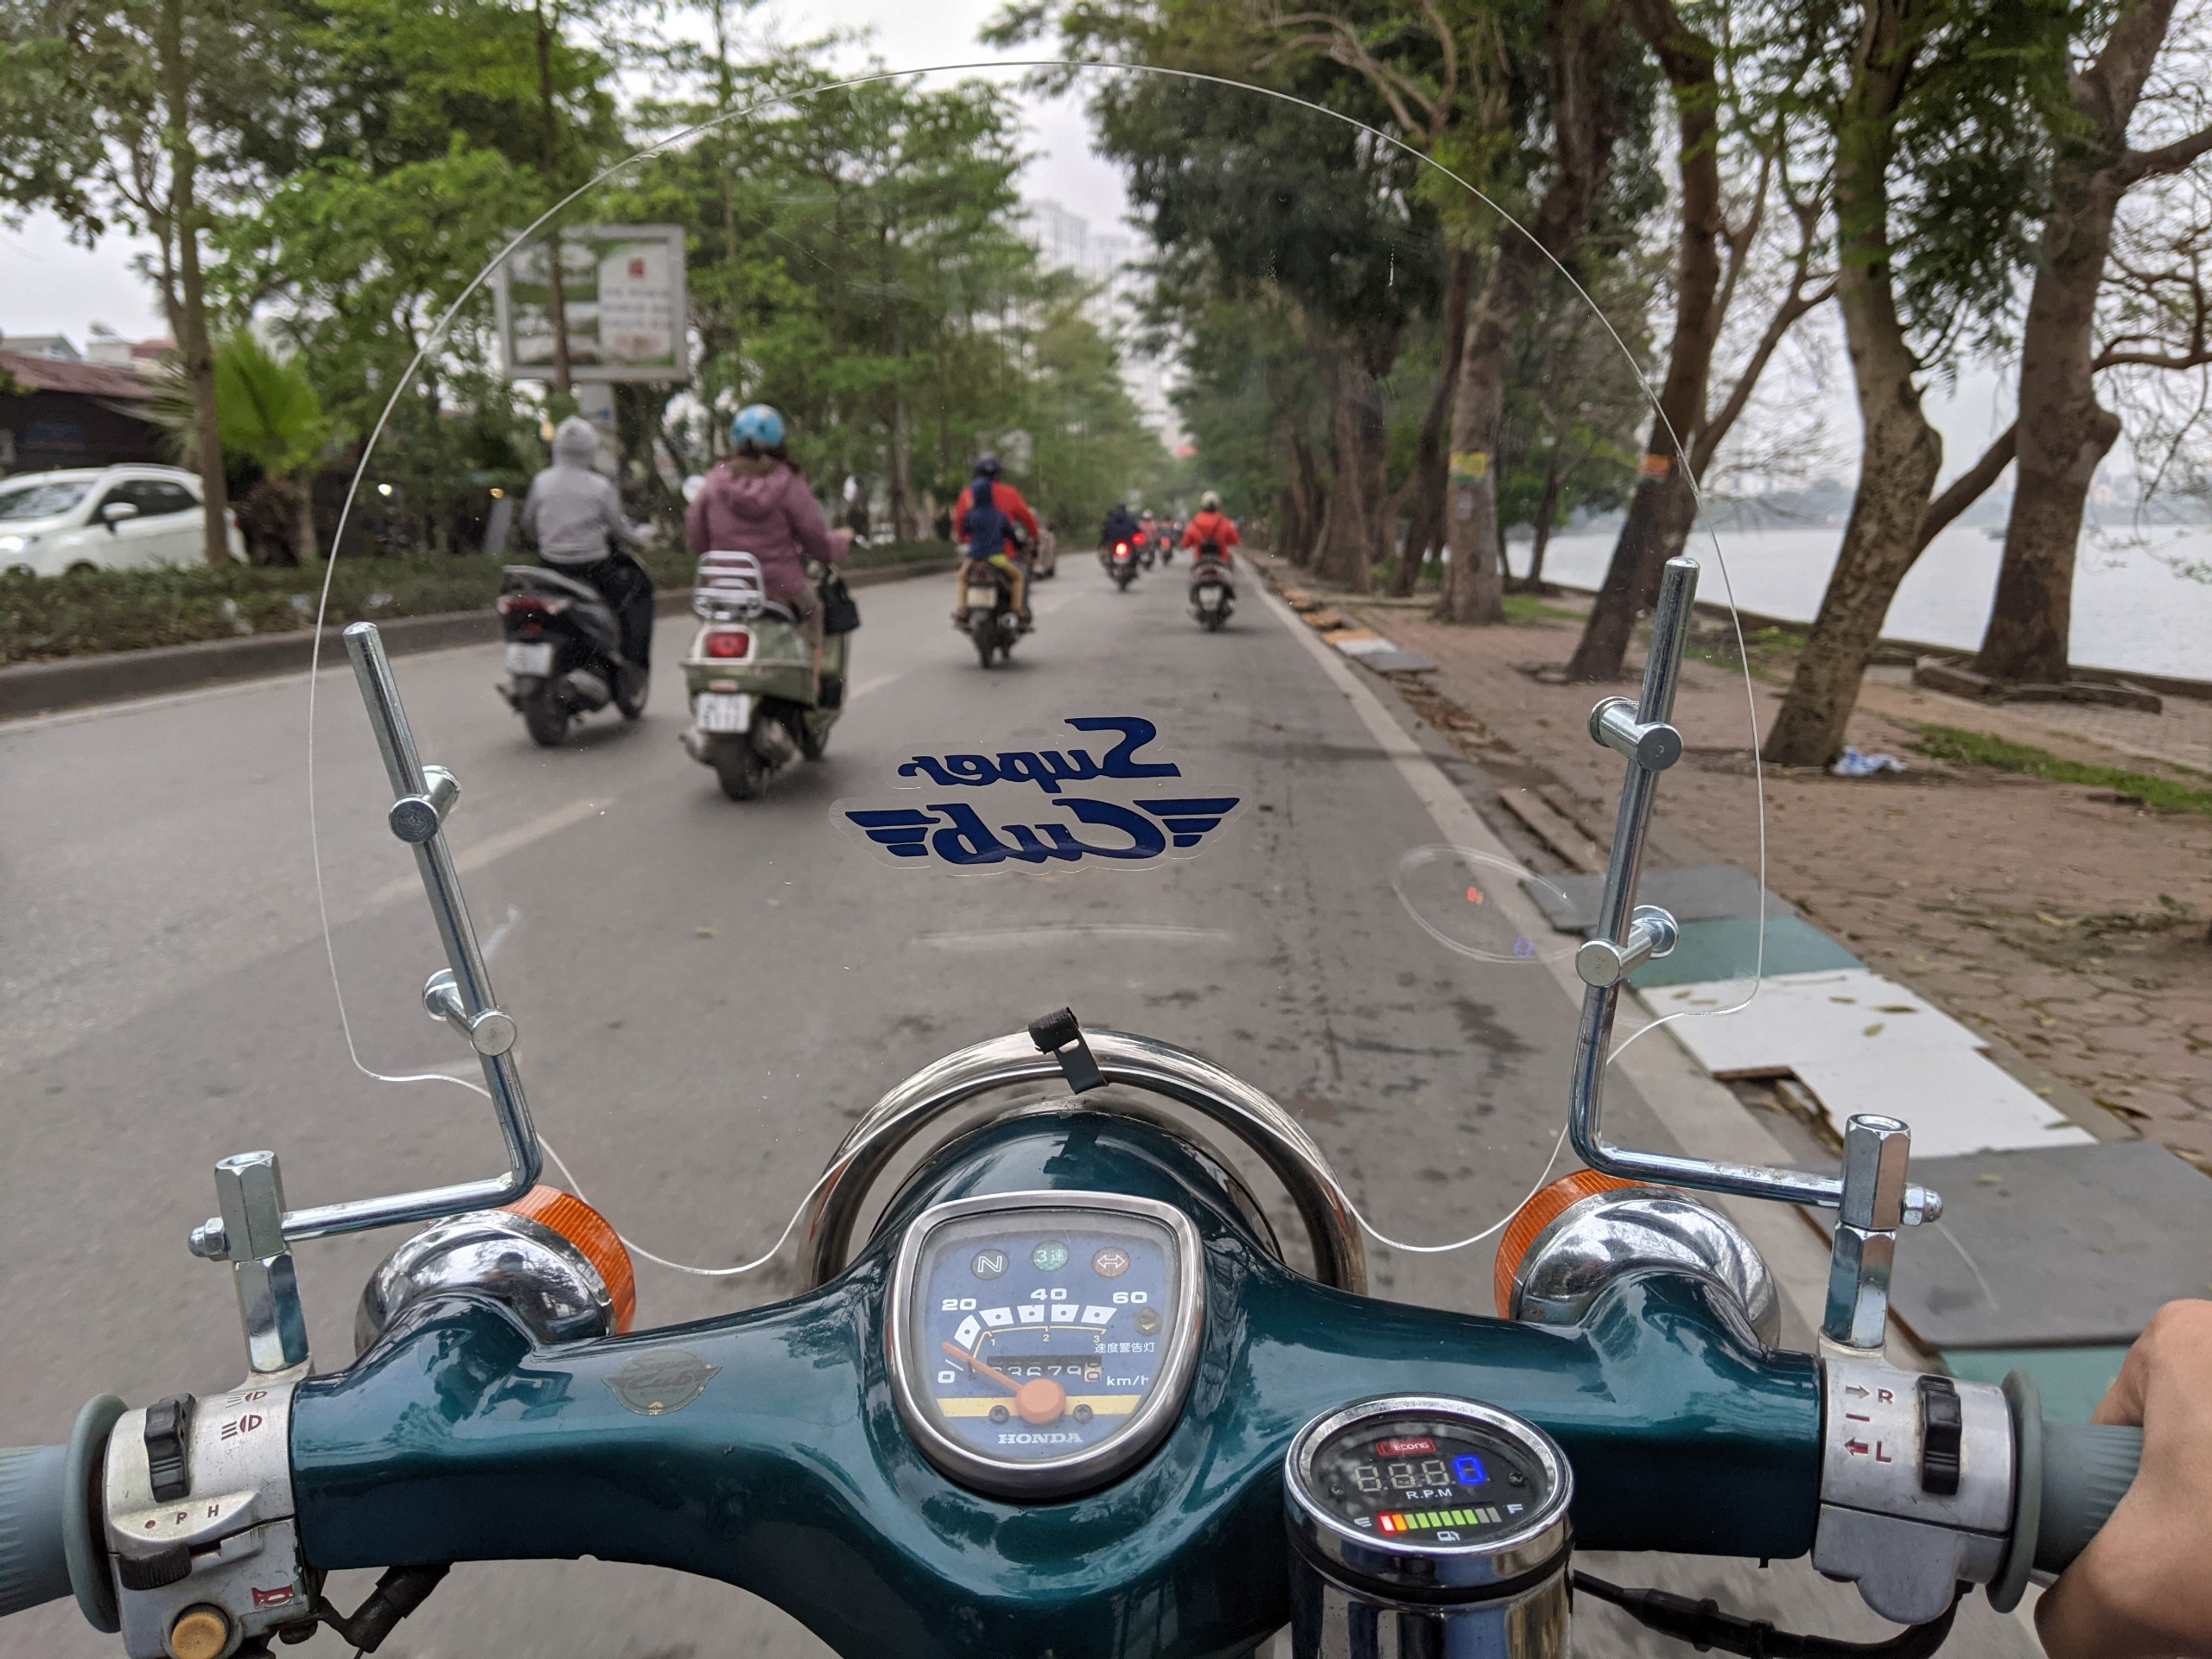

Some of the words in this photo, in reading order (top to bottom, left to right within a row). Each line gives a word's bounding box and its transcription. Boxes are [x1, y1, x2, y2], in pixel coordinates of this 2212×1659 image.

[1036, 1249, 1065, 1263] 3速
[977, 1255, 1002, 1273] N
[1030, 1287, 1067, 1300] 40
[1112, 1291, 1147, 1304] 60
[941, 1298, 977, 1311] 20
[1043, 1333, 1050, 1342] 2
[1094, 1342, 1155, 1353] 速度警告灯
[938, 1370, 956, 1383] 0
[1107, 1375, 1149, 1386] km/h
[1878, 1388, 1893, 1404] R
[998, 1433, 1084, 1444] HONDA
[1876, 1440, 1891, 1463] L
[1406, 1488, 1452, 1499] R.P.M
[175, 1512, 188, 1524] P
[207, 1504, 219, 1517] H
[1506, 1503, 1523, 1514] F
[1353, 1516, 1372, 1529] E
